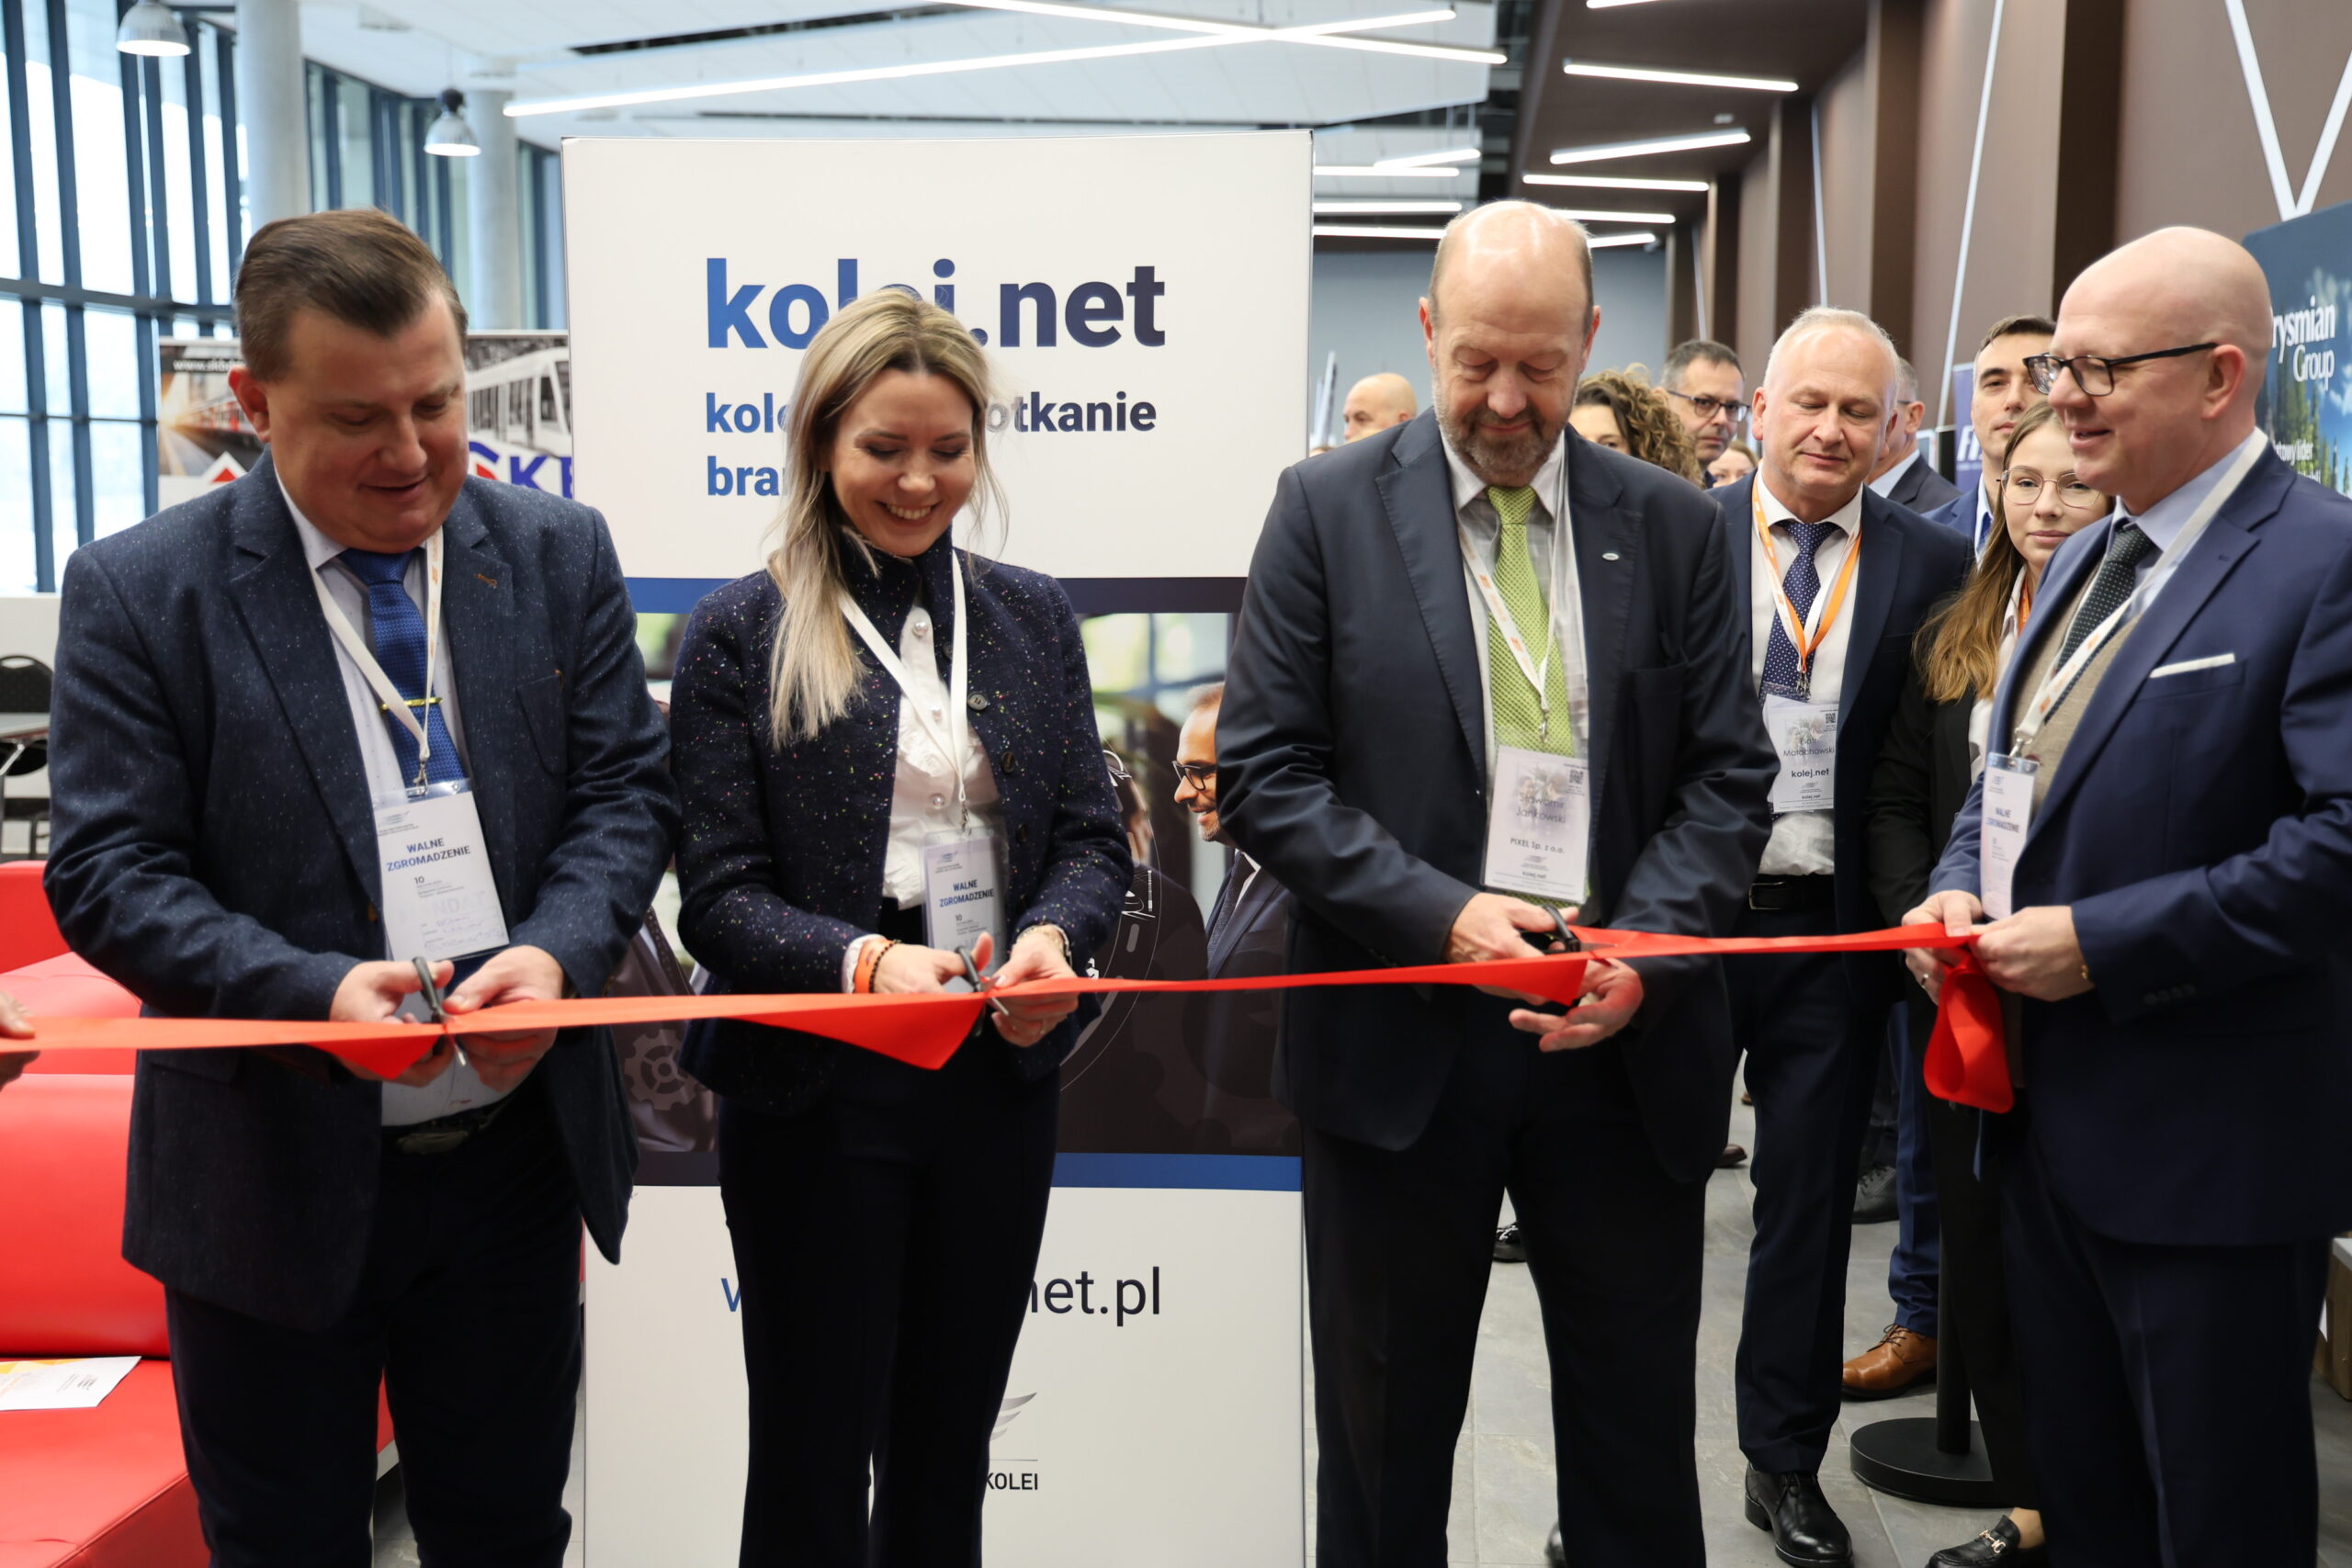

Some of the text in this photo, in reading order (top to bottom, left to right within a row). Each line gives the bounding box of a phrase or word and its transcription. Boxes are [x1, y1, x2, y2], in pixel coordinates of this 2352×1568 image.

[706, 257, 1166, 348] kol.net
[2270, 295, 2335, 364] rysmian
[2292, 344, 2335, 391] Group
[986, 390, 1158, 433] otkanie
[2272, 441, 2296, 466] towy
[706, 456, 786, 497] bra
[1792, 768, 1829, 779] kolej.net
[386, 845, 471, 872] ZGROMADZENIE
[407, 838, 445, 853] WALNE
[414, 875, 424, 885] 10
[953, 879, 978, 892] WALNE
[939, 888, 995, 908] ZGROMADZENIE
